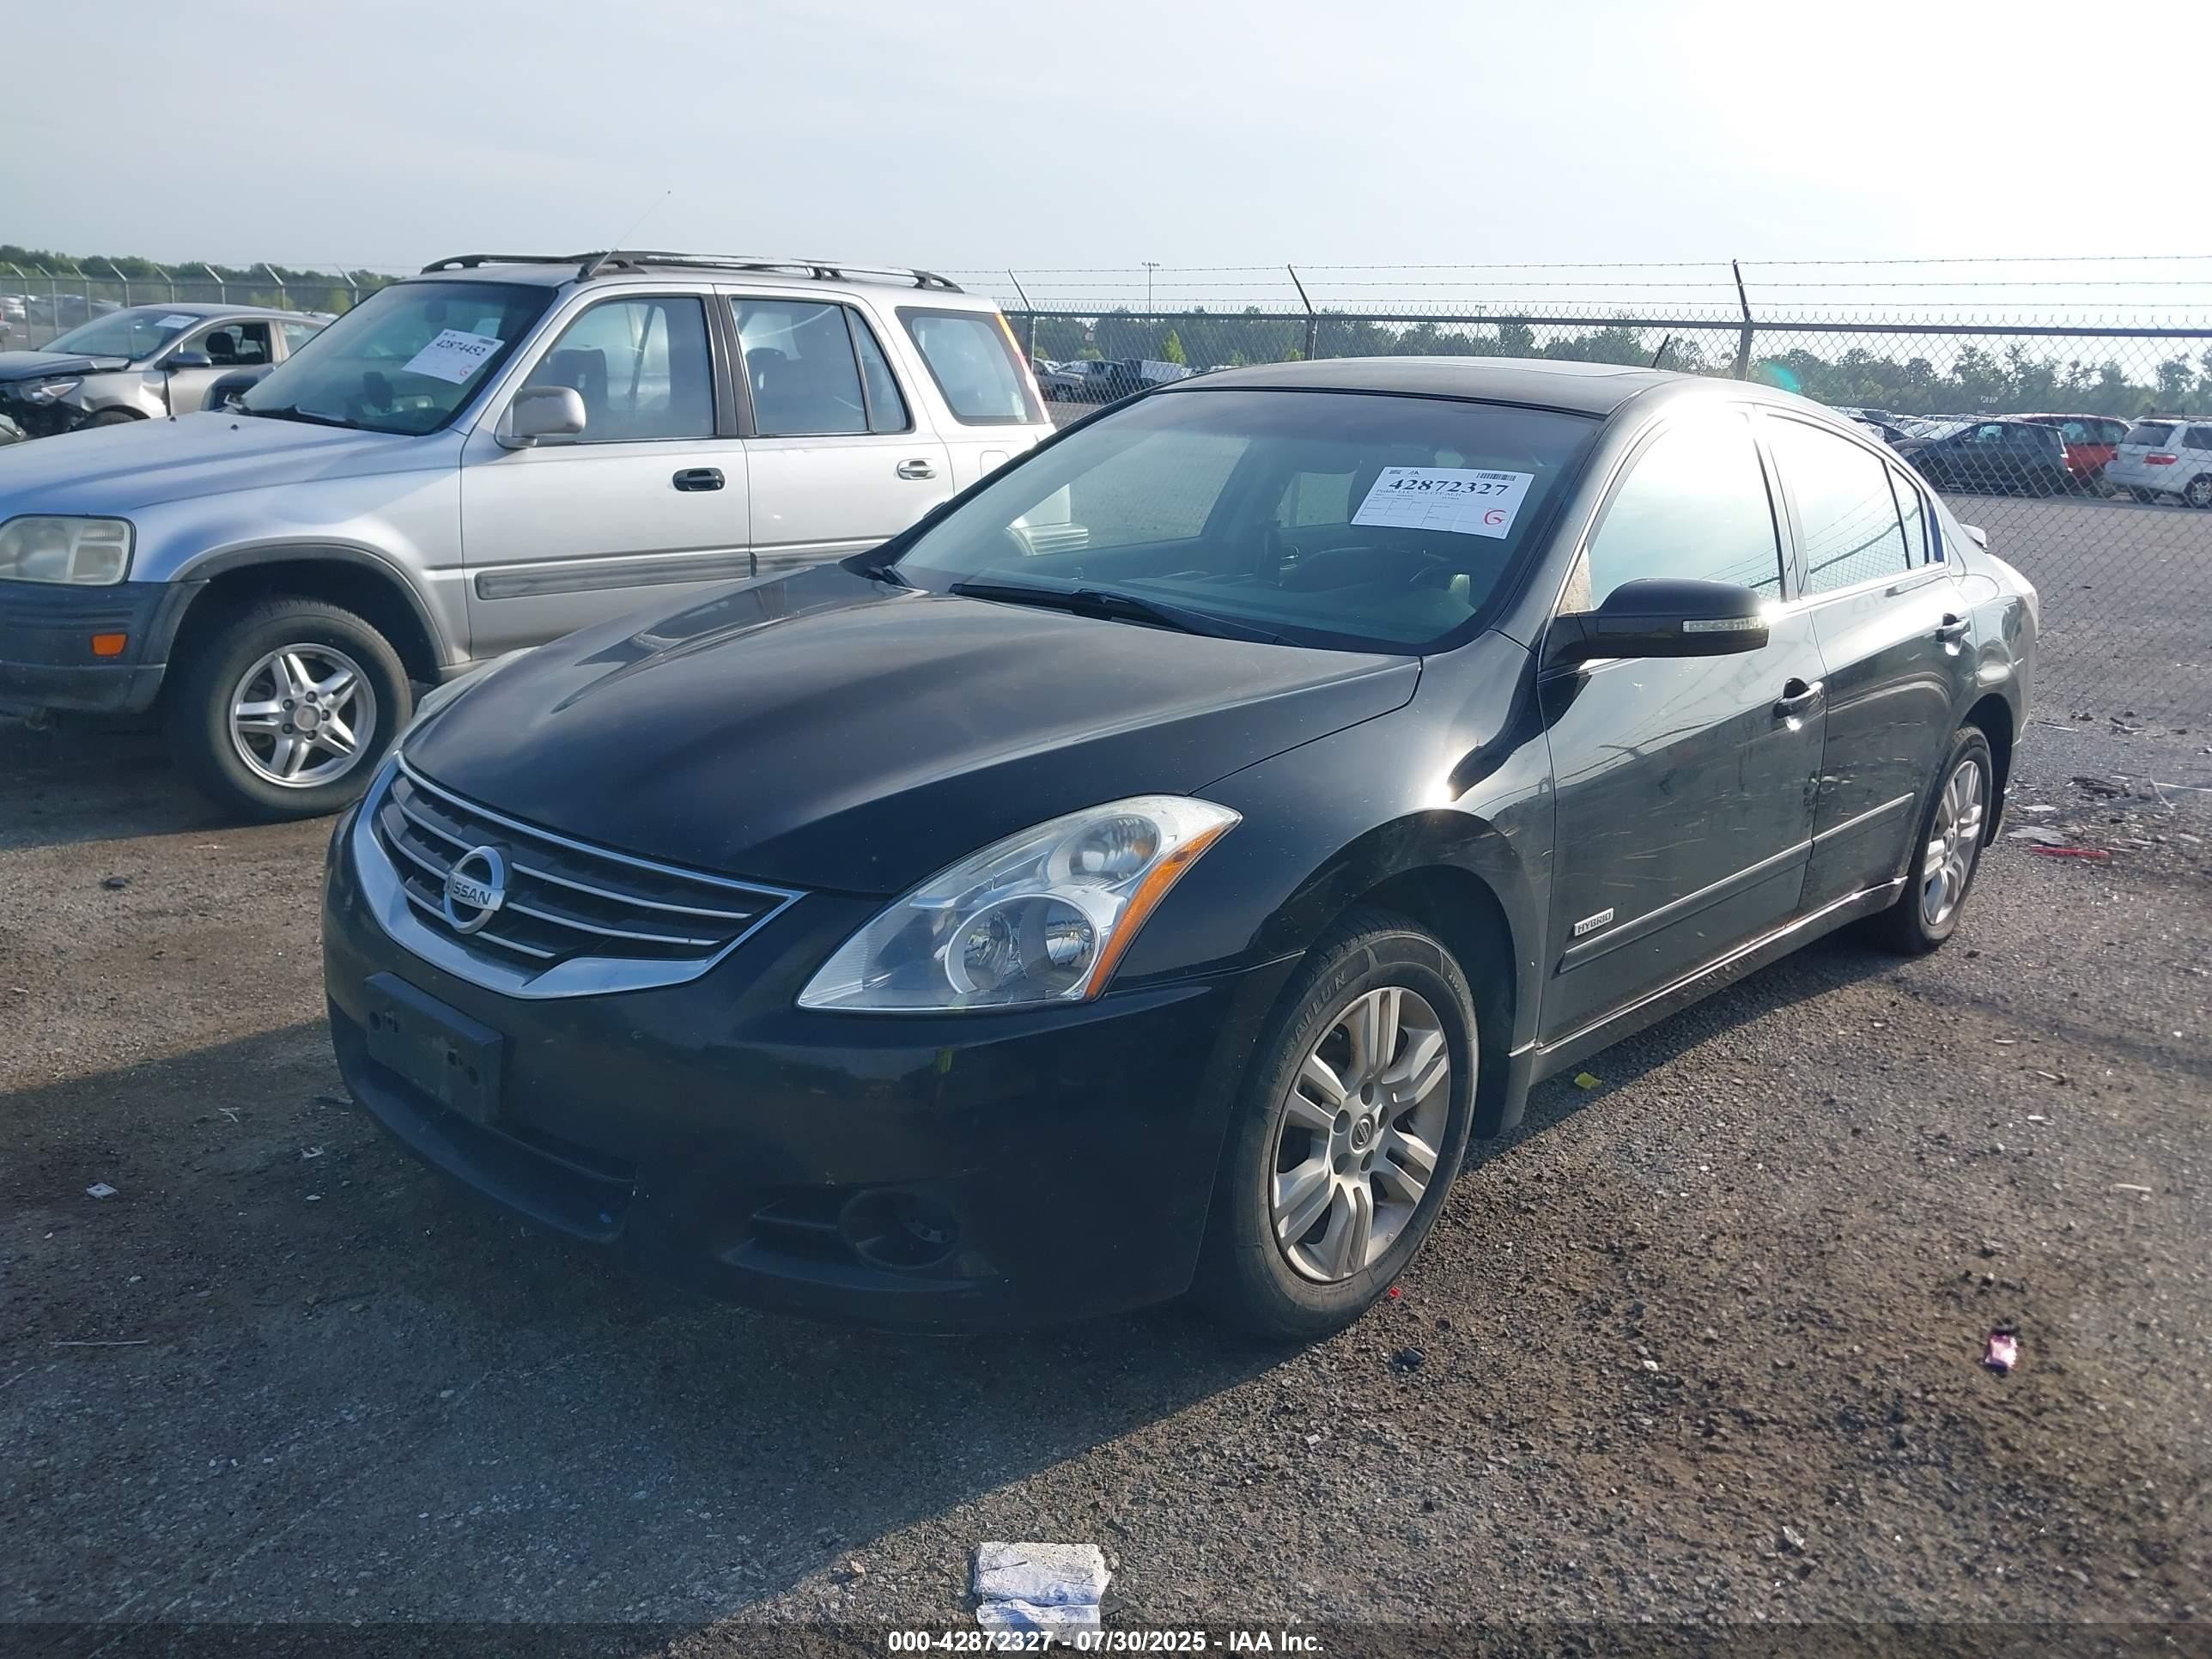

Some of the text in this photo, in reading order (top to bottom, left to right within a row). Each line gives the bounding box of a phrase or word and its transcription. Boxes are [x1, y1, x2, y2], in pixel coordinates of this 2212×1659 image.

[436, 339, 487, 356] 42874452
[1389, 478, 1510, 496] 42872327
[1484, 509, 1507, 526] G
[1577, 913, 1612, 933] HYBRID
